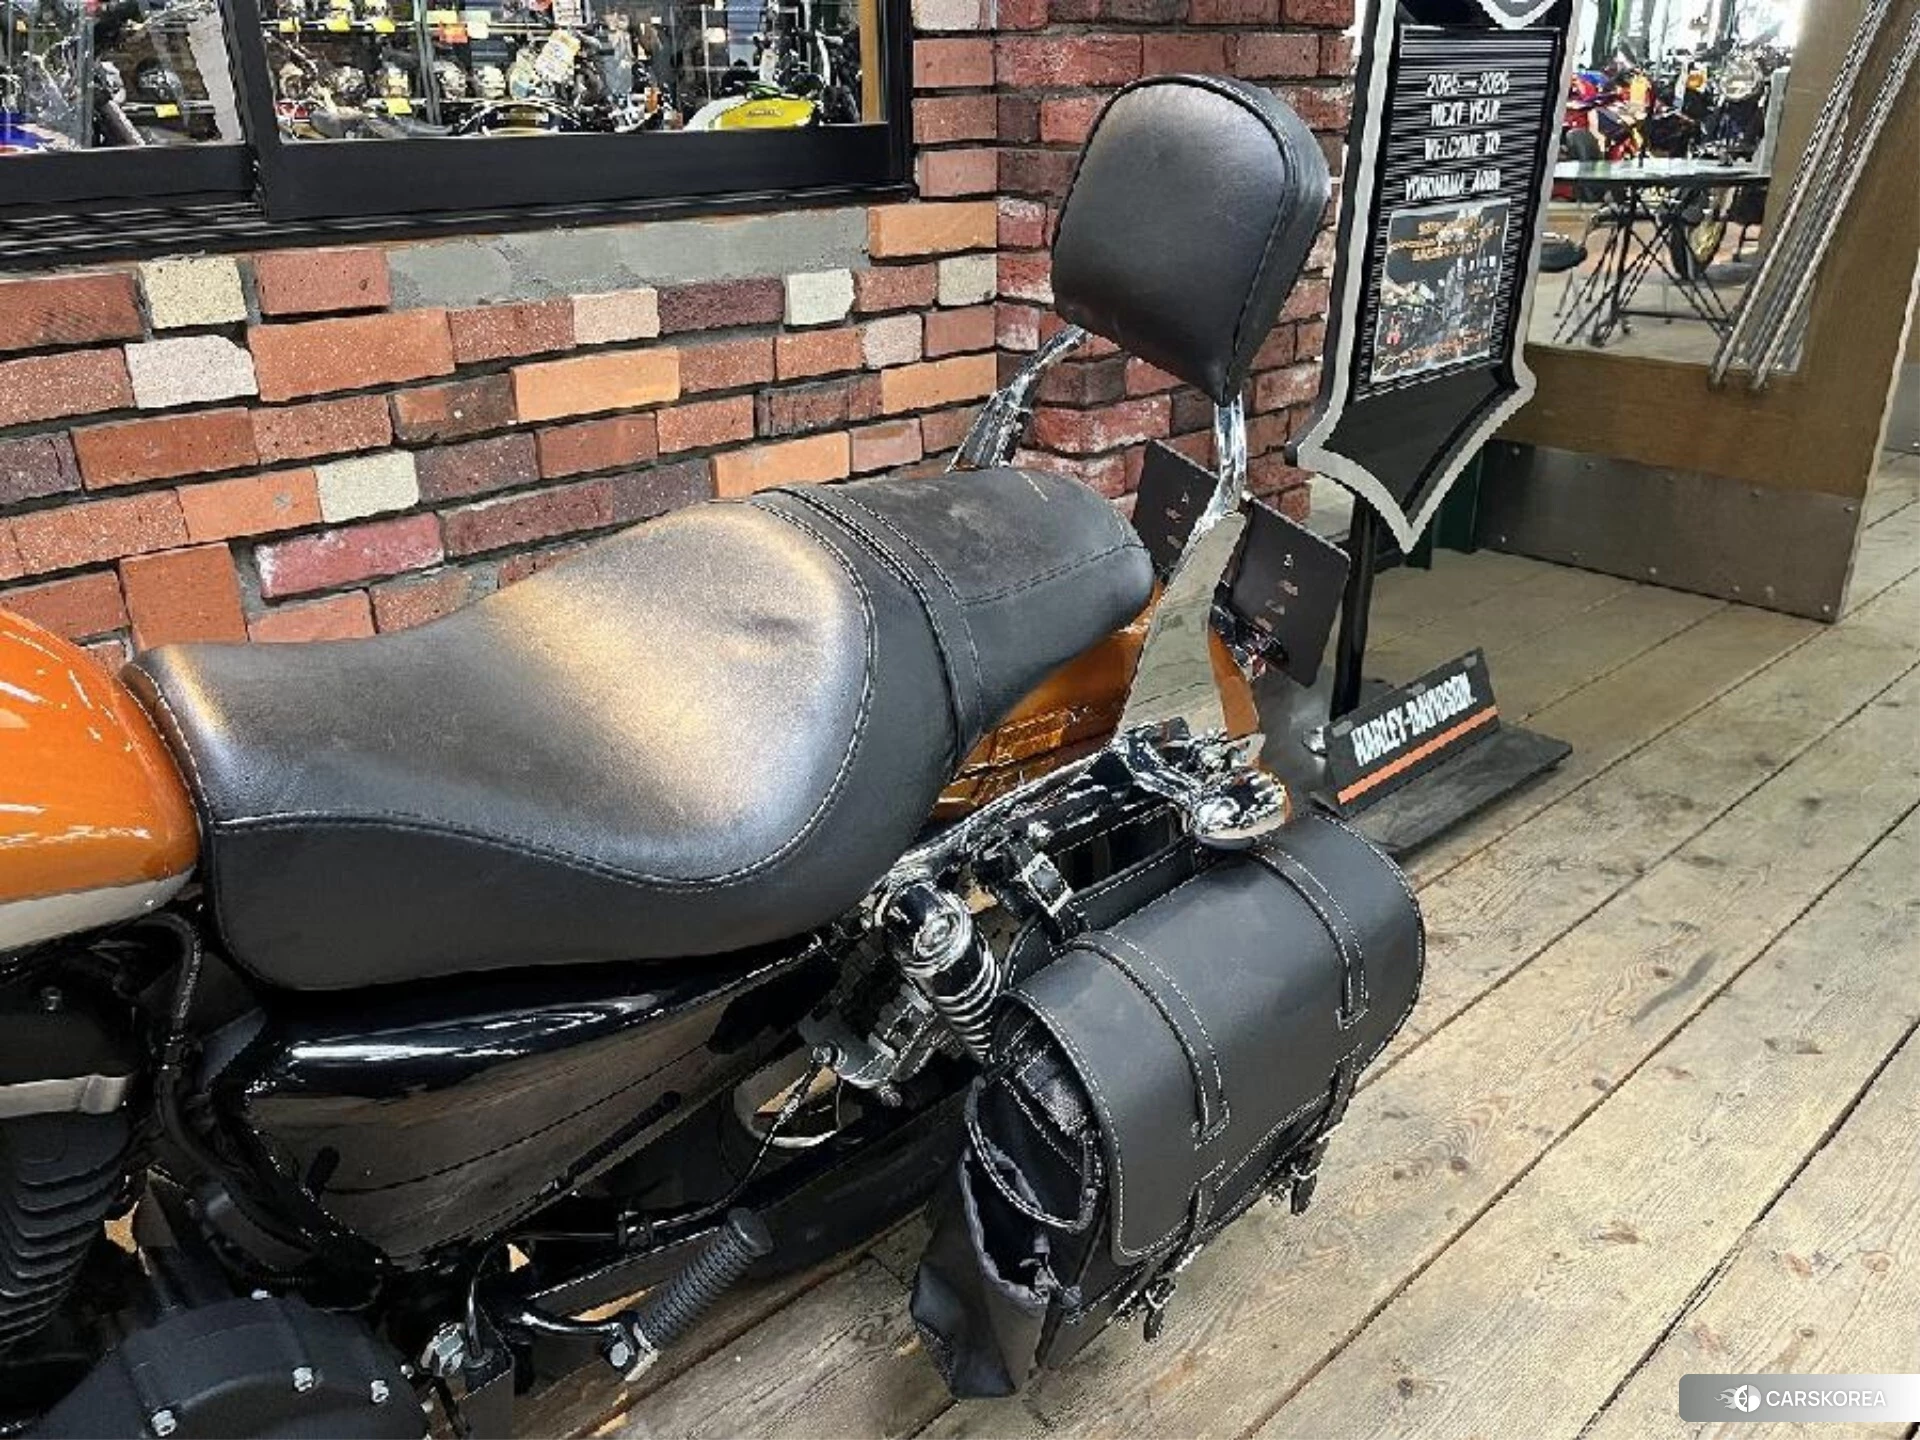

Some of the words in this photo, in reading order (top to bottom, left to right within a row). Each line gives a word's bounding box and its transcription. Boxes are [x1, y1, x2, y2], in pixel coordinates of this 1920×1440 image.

[1430, 102, 1465, 127] NEXT
[1469, 99, 1501, 125] YEAR
[1424, 134, 1482, 161] WELCOME
